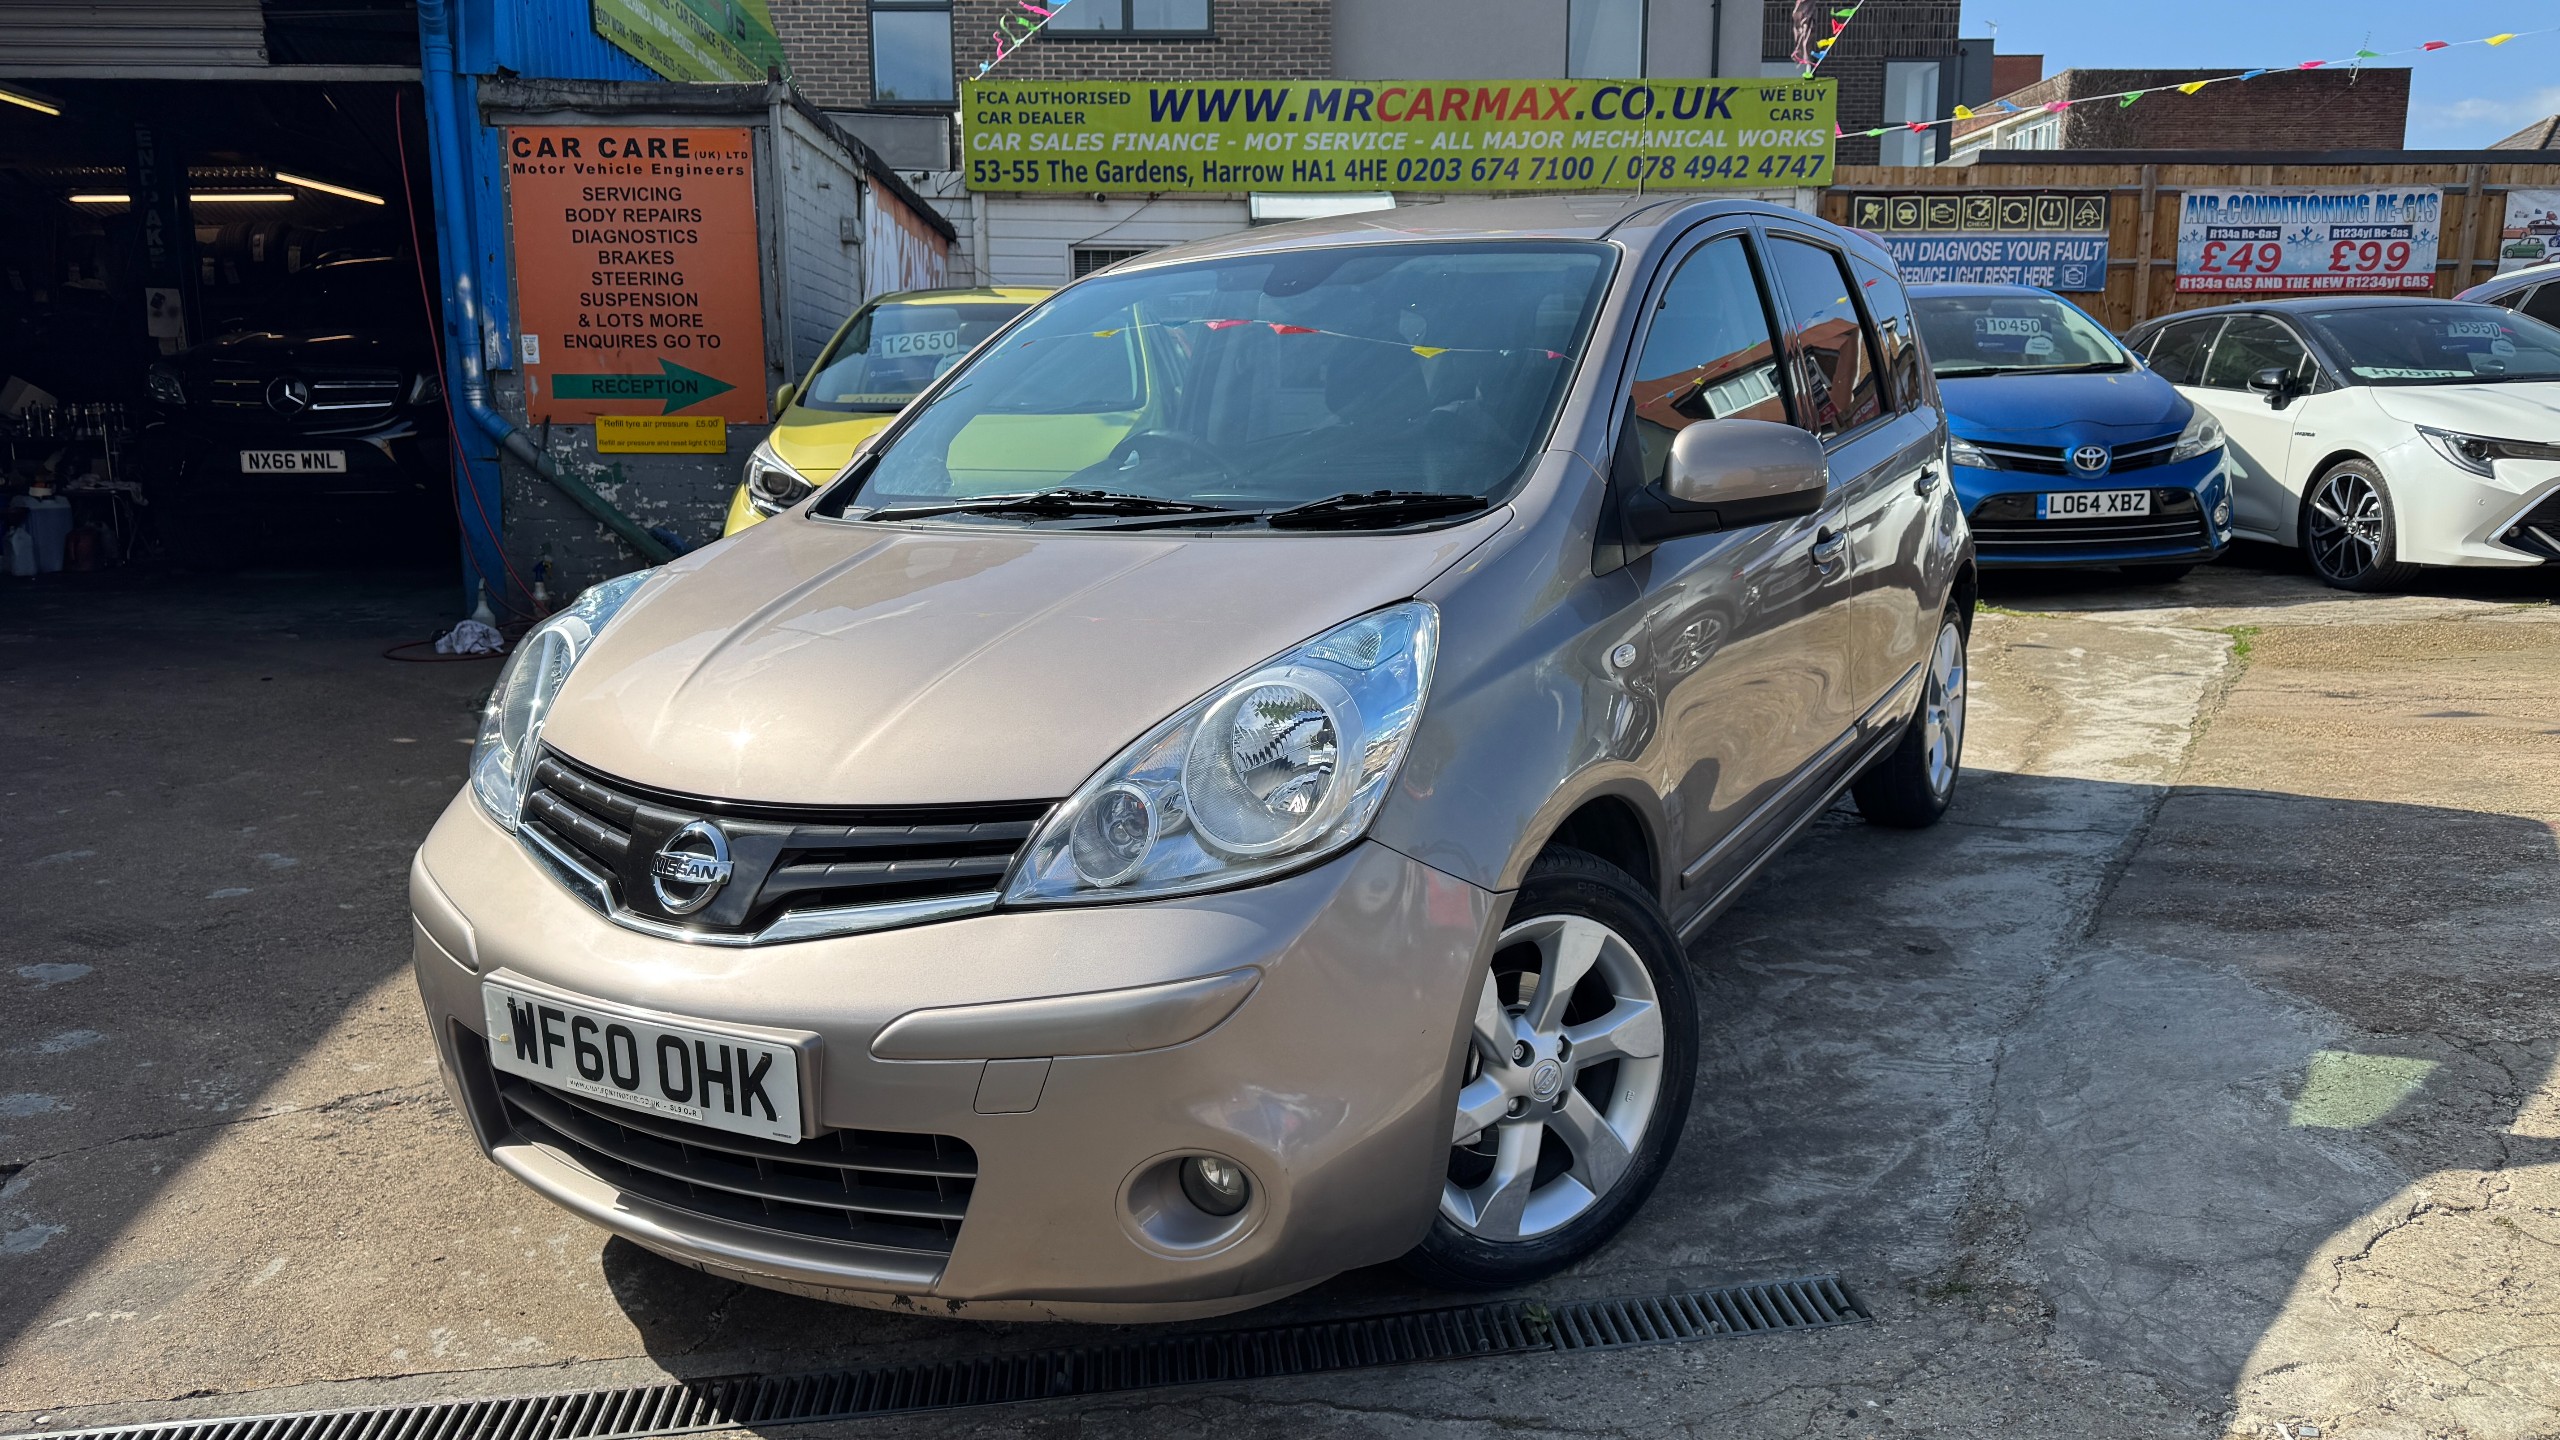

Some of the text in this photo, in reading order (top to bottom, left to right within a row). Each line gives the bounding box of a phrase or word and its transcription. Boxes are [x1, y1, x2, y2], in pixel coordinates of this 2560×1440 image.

[690, 13, 716, 49] FINANCE
[976, 91, 1132, 105] FCA AUTHORISED
[1760, 88, 1828, 102] WE BUY
[1148, 85, 1740, 123] WWW.MRCARMAX.CO.UK
[977, 111, 1086, 125] CAR DEALER
[1769, 108, 1815, 121] CARS
[972, 132, 1021, 152] CAR
[1028, 132, 1106, 151] SALES
[1112, 132, 1221, 151] FINANCE
[1244, 131, 1299, 151] MOT
[1303, 131, 1409, 151] SERVICE
[1431, 131, 1472, 150] ALL
[1482, 130, 1565, 150] MAJOR
[1571, 129, 1729, 149] MECHANICAL
[1737, 128, 1826, 148] WORKS
[512, 137, 749, 160] CAR CARE (UK) LTD
[512, 163, 745, 177] Motor Vehicle Engineers
[973, 160, 1040, 184] 53-55
[1046, 160, 1089, 184] The
[1095, 159, 1195, 187] Gardens,
[1202, 159, 1285, 184] Harrow
[1292, 159, 1335, 184] HA1
[1344, 158, 1388, 183] 4HE
[1396, 157, 1462, 182] 0203
[1470, 157, 1519, 182] 674
[1527, 156, 1595, 181] 7100
[1626, 155, 1677, 180] 078
[1683, 154, 1748, 179] 4942
[1757, 154, 1826, 179] 4747
[582, 186, 683, 202] SERVICING
[565, 208, 703, 223] BODY REPAIRS
[2183, 192, 2439, 225] AIR-CONDITIONING RE-GAS
[572, 229, 698, 244] DIAGNOSTICS
[2209, 228, 2279, 240] R134a Re-Gas
[2373, 227, 2410, 238] Re-Gas
[598, 250, 675, 265] BRAKES
[1918, 241, 2003, 262] DIAGNOSE
[2006, 241, 2051, 261] YOUR
[2053, 241, 2106, 261] FAULT
[2199, 241, 2283, 274] £49
[2328, 240, 2411, 273] £99
[591, 271, 684, 287] STEERING
[1899, 266, 1947, 284] SERVICE
[1948, 266, 1982, 284] LIGHT
[1985, 266, 2020, 284] RESET
[2023, 266, 2056, 287] HERE
[2179, 275, 2430, 290] R134a GAS AND THE NEW R1234yf GAS
[580, 292, 698, 307] SUSPENSION
[578, 313, 704, 328] & LOTS MORE
[563, 334, 722, 349] ENQUIRES GO TO
[592, 379, 699, 394] RECEPTION
[604, 419, 719, 429] Refill tyre air pressure £5.00
[248, 453, 338, 469] NX66 WNL
[2050, 494, 2146, 514] LO64 XBZ
[652, 858, 719, 880] NISSAN
[507, 997, 778, 1123] WF60 OHK
